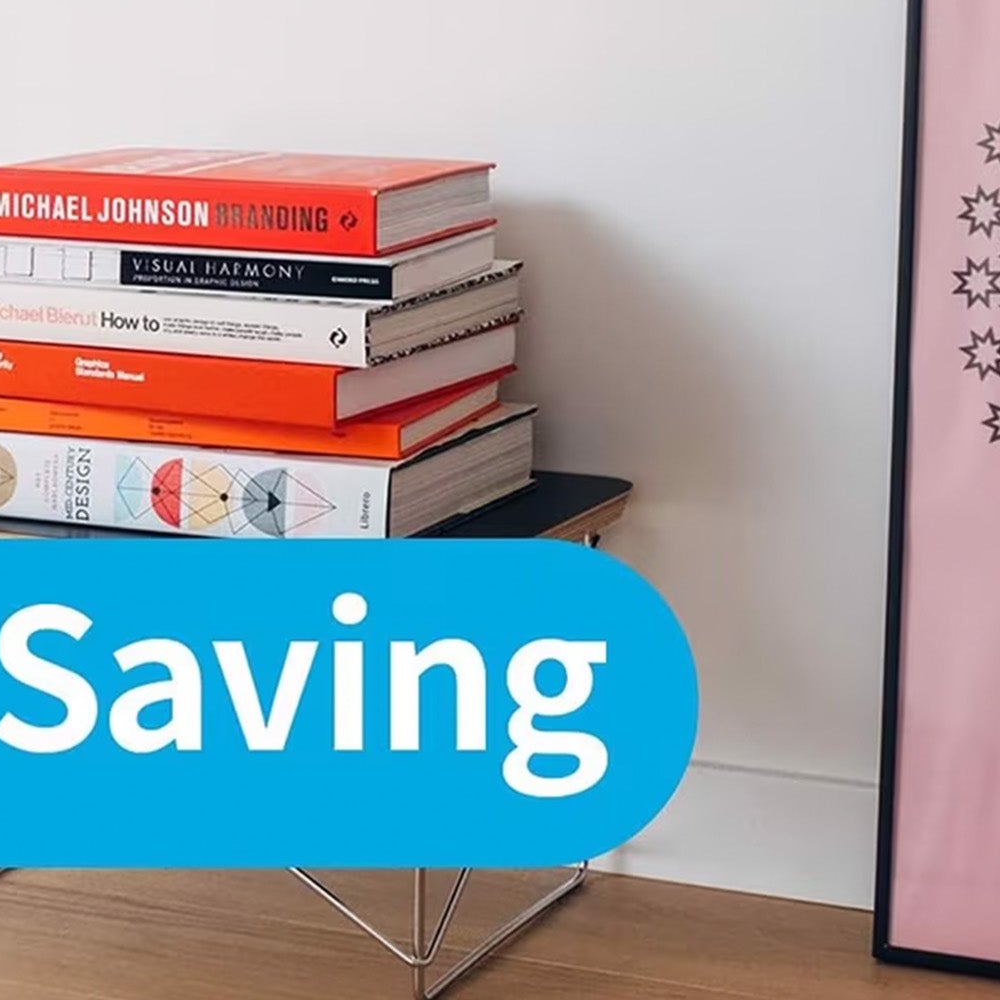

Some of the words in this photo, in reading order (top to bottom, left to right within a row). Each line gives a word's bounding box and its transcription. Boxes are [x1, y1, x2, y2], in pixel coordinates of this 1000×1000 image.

[97, 197, 209, 227] JOHNSON
[215, 203, 328, 233] BRANDING
[132, 257, 195, 274] VISUAL
[205, 261, 305, 279] HARMONY
[101, 311, 140, 331] How
[143, 315, 160, 332] to
[75, 447, 91, 521] DESIGN
[360, 491, 371, 530] Librero
